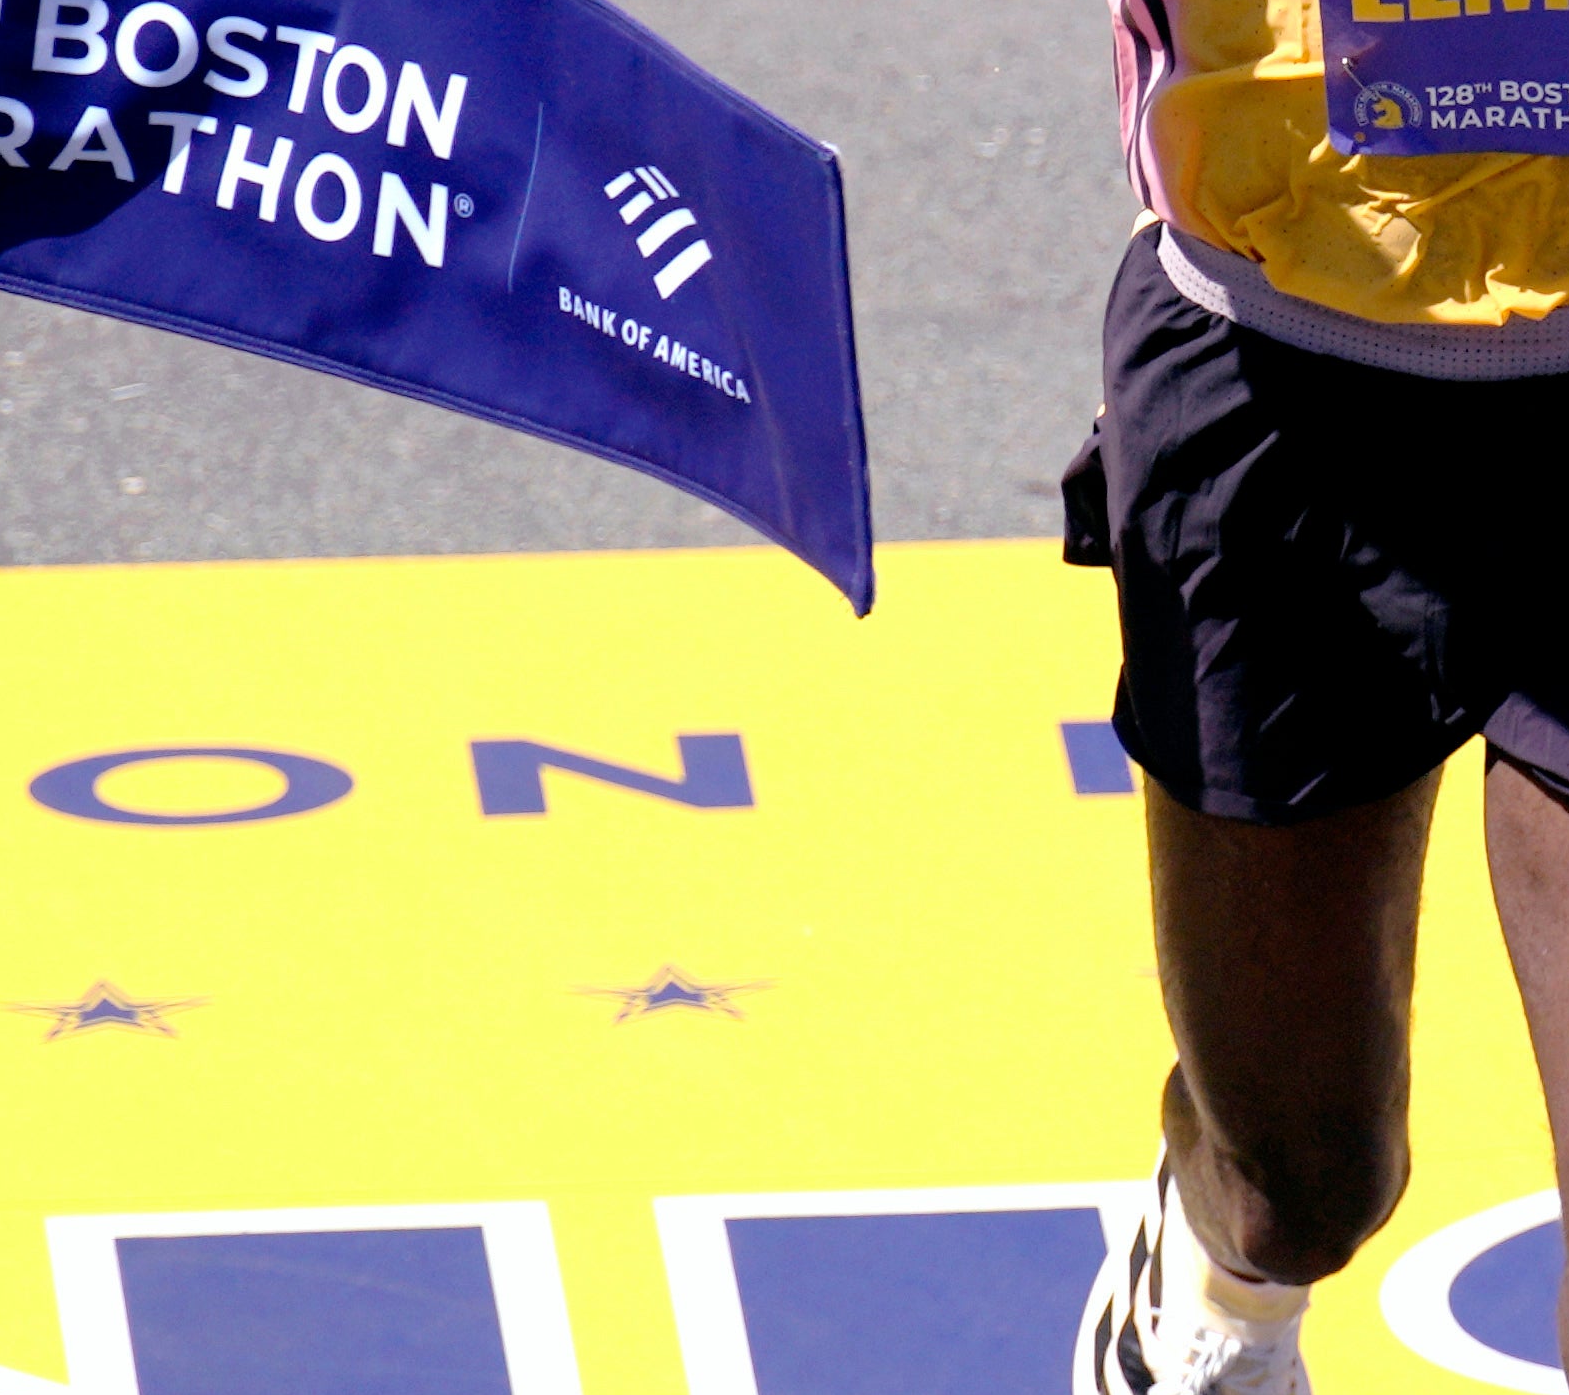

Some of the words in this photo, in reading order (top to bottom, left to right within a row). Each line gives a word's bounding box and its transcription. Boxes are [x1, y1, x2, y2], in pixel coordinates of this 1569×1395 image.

[1426, 82, 1493, 108] 128TH
[558, 286, 617, 338] BANK
[621, 318, 653, 352] OF
[653, 334, 751, 404] AMERICA
